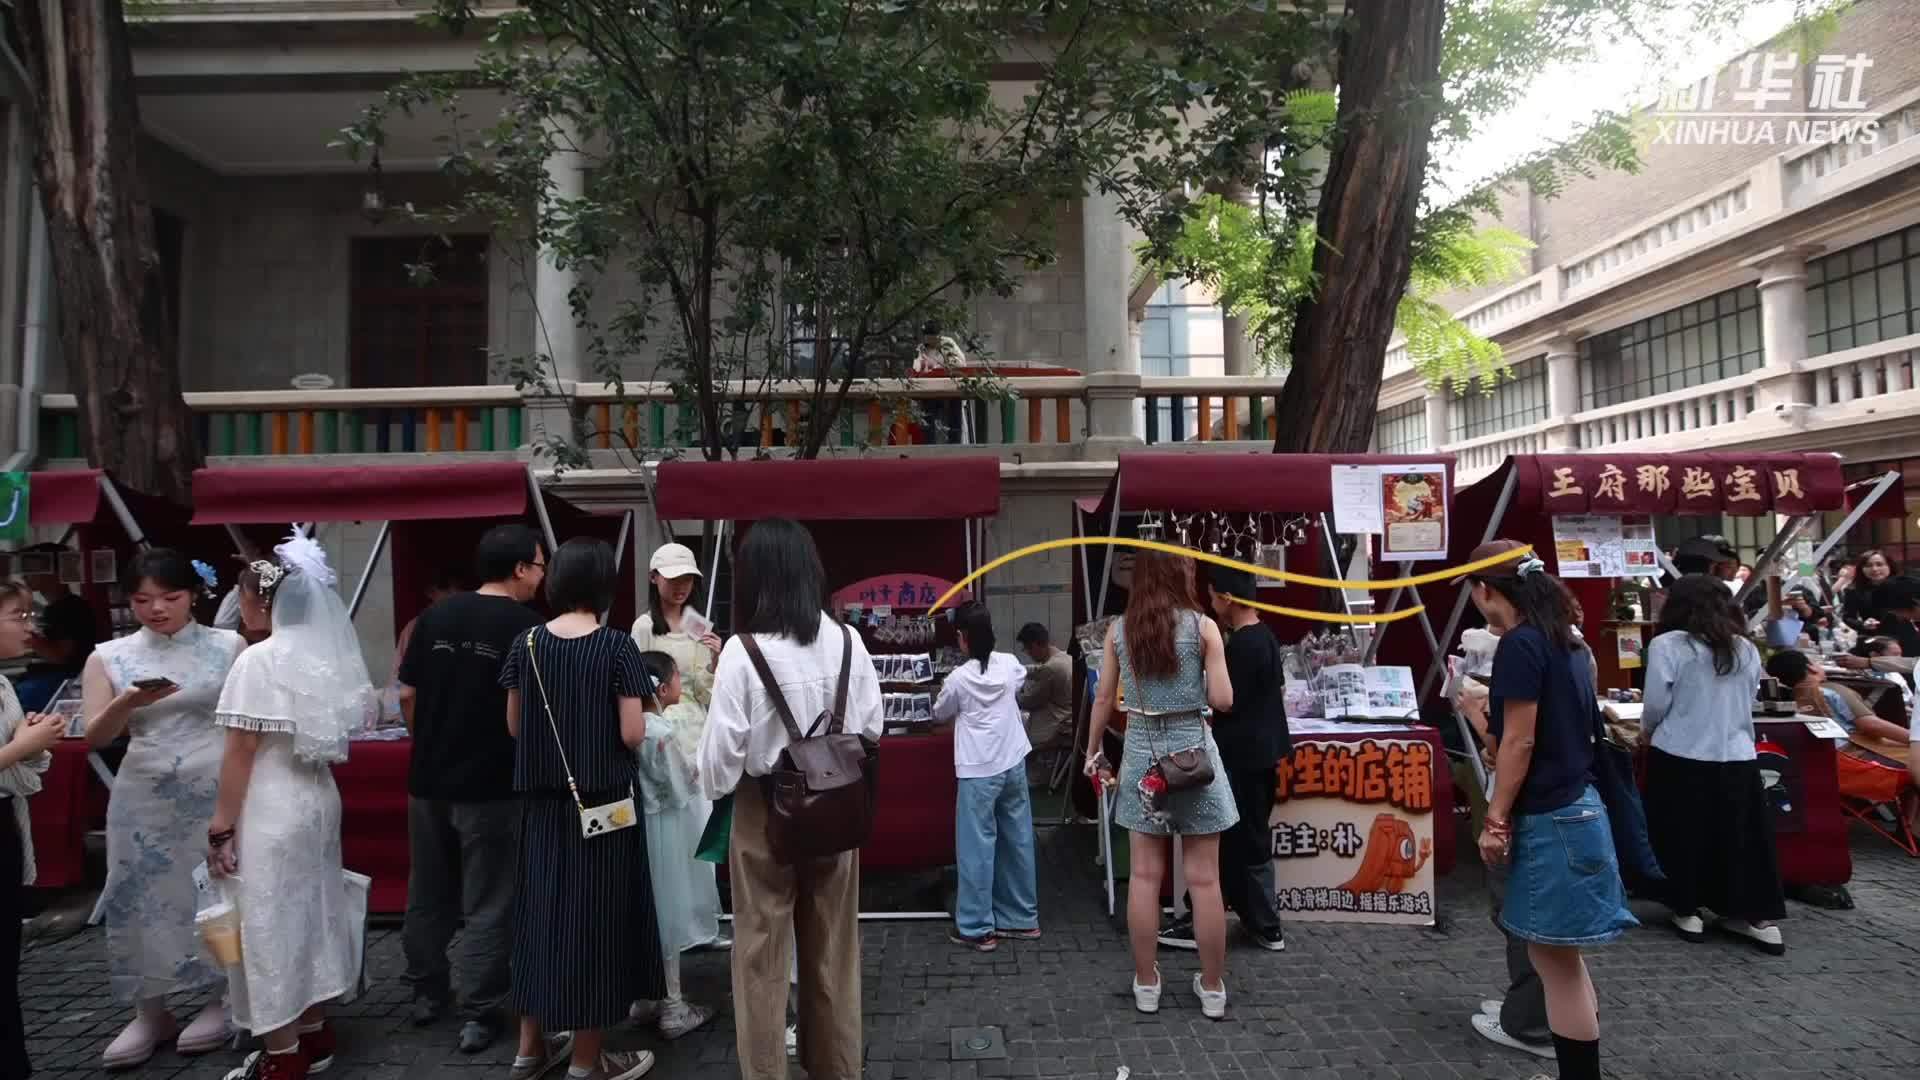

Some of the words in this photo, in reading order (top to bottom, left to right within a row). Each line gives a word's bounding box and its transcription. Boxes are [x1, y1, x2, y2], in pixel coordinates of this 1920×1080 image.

[1548, 463, 1804, 502] 王府那些宝贝
